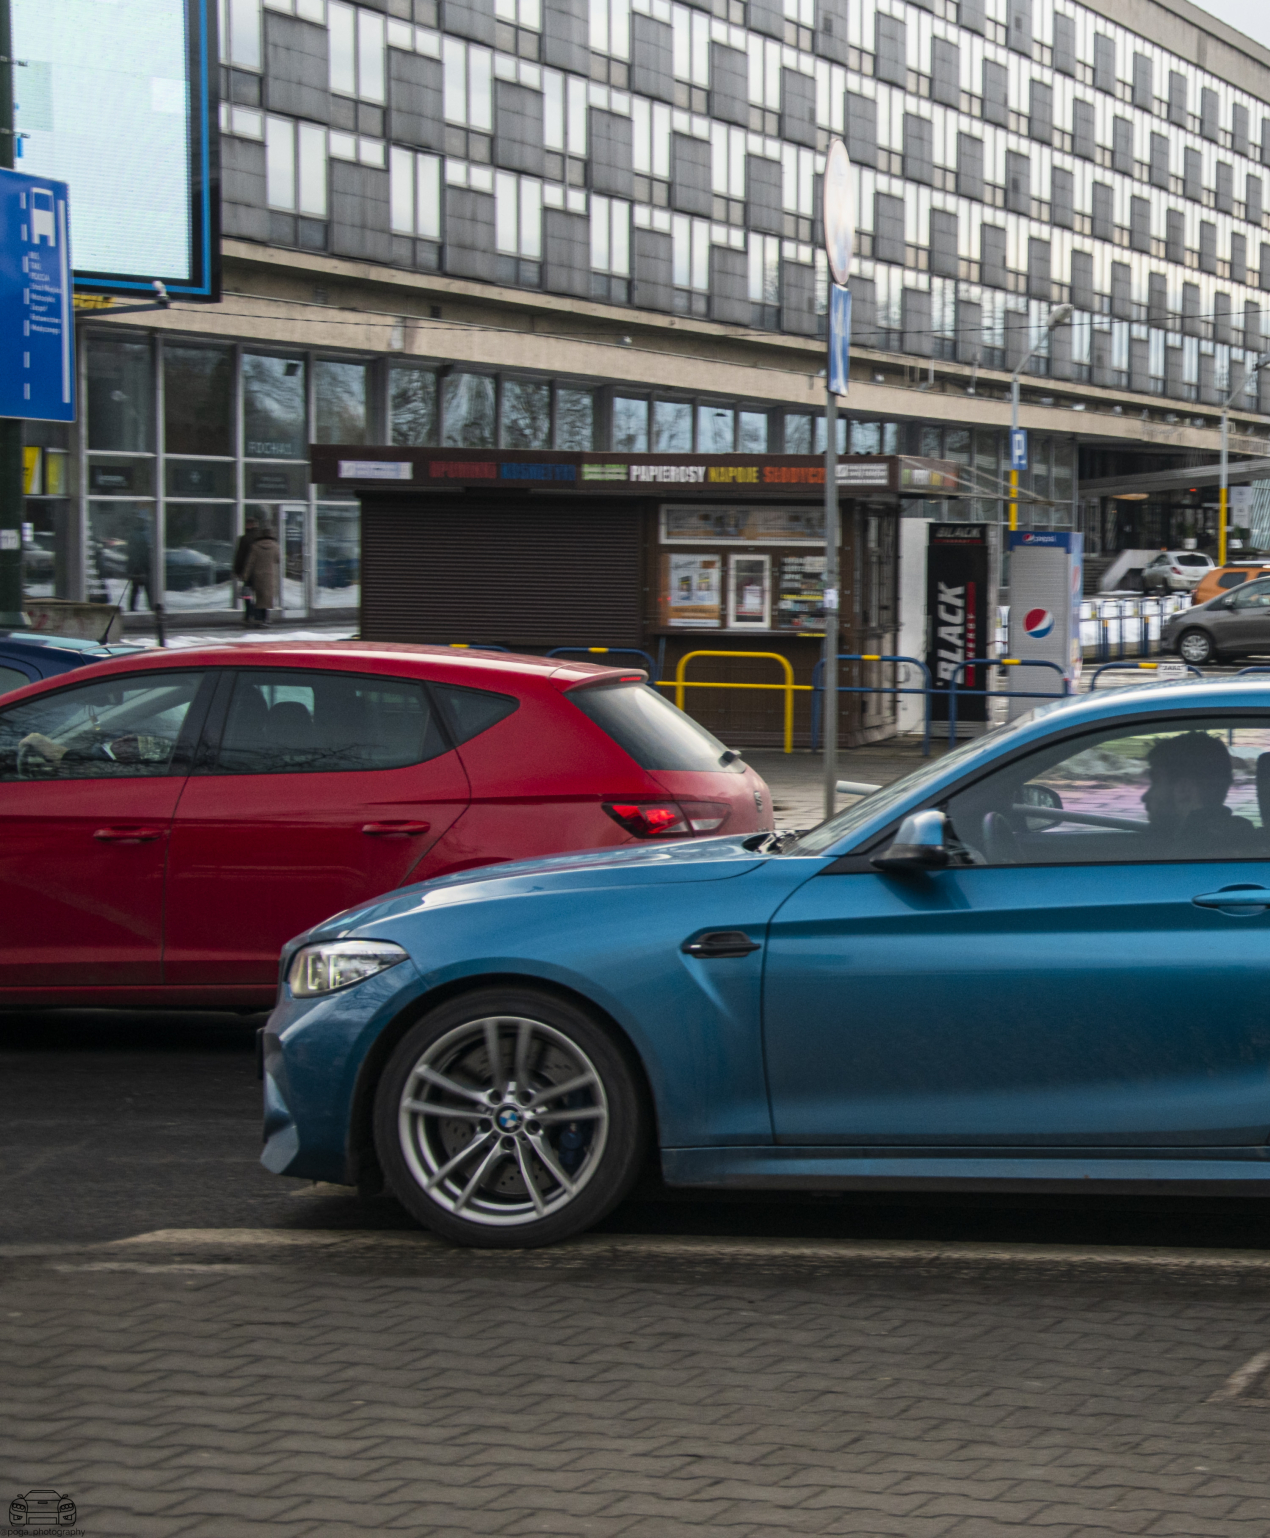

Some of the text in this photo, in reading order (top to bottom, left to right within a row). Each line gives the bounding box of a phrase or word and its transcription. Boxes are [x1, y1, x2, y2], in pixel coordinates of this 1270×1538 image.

[630, 466, 706, 482] PAPIEROSY
[708, 467, 759, 482] NAPOJE
[762, 467, 826, 483] SŁODYCZ
[936, 526, 982, 538] BLACK
[937, 581, 966, 685] BLACK
